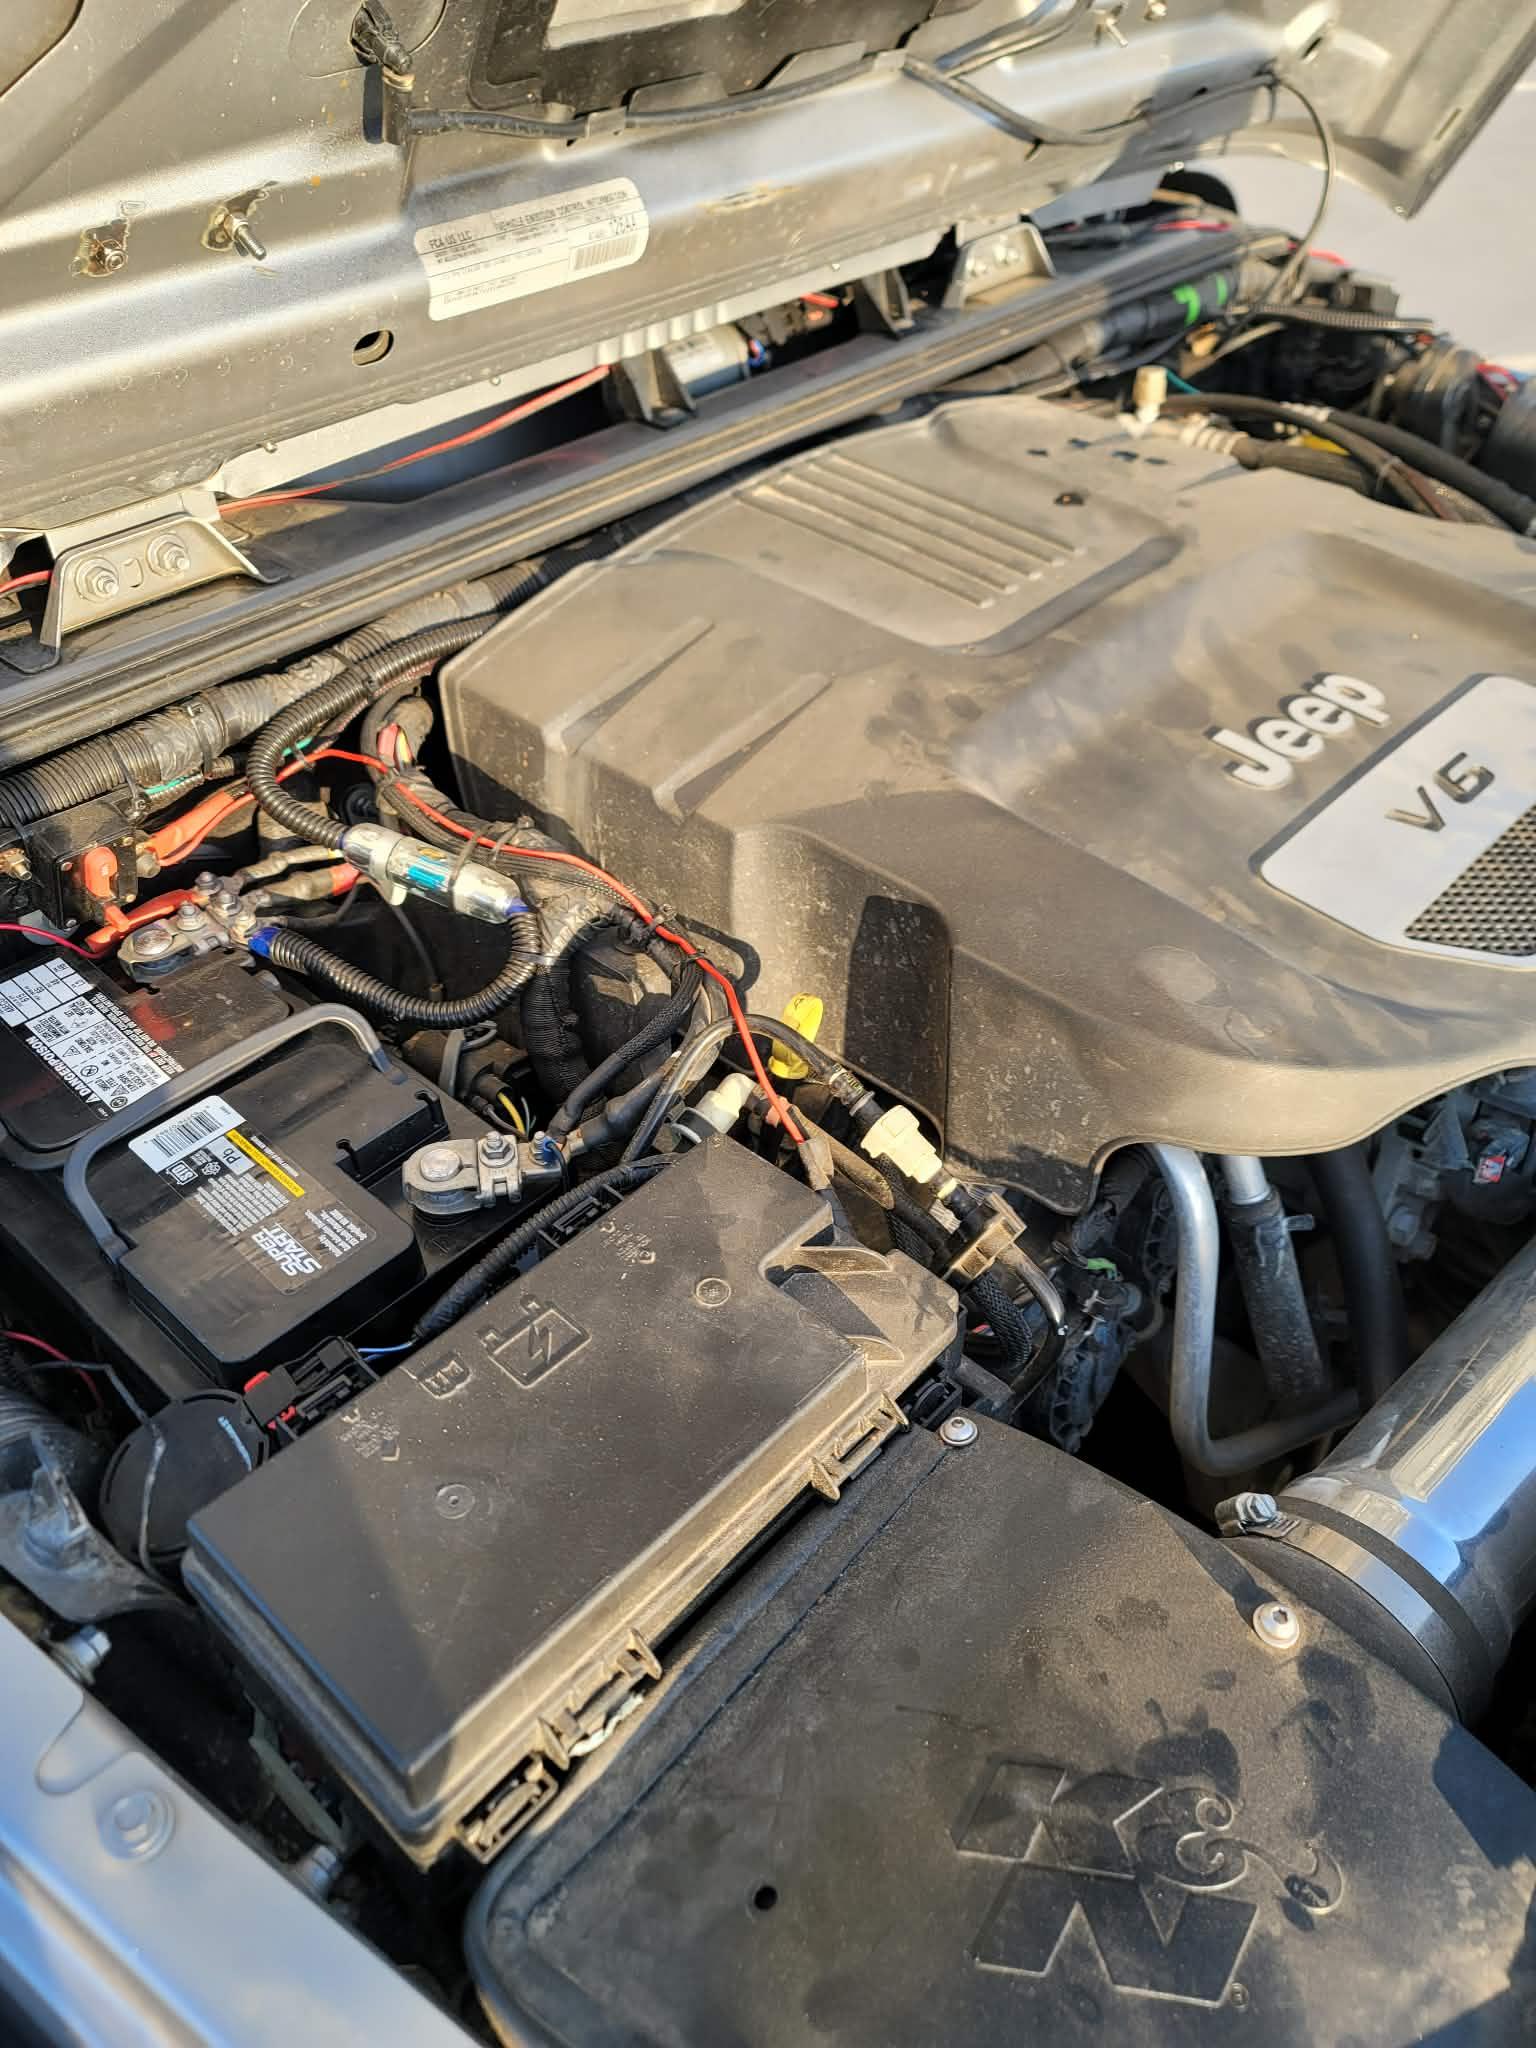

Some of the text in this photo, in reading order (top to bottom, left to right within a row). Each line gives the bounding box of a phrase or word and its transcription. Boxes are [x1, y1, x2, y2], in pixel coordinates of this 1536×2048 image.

[428, 237, 445, 250] FCA
[1204, 672, 1390, 790] Jeep
[1384, 752, 1495, 832] V6
[25, 1034, 91, 1098] DANGER/POISON
[223, 1147, 241, 1164] Pb
[251, 1230, 304, 1277] SUPER
[261, 1225, 322, 1274] START
[954, 1752, 1344, 2008] K&N
